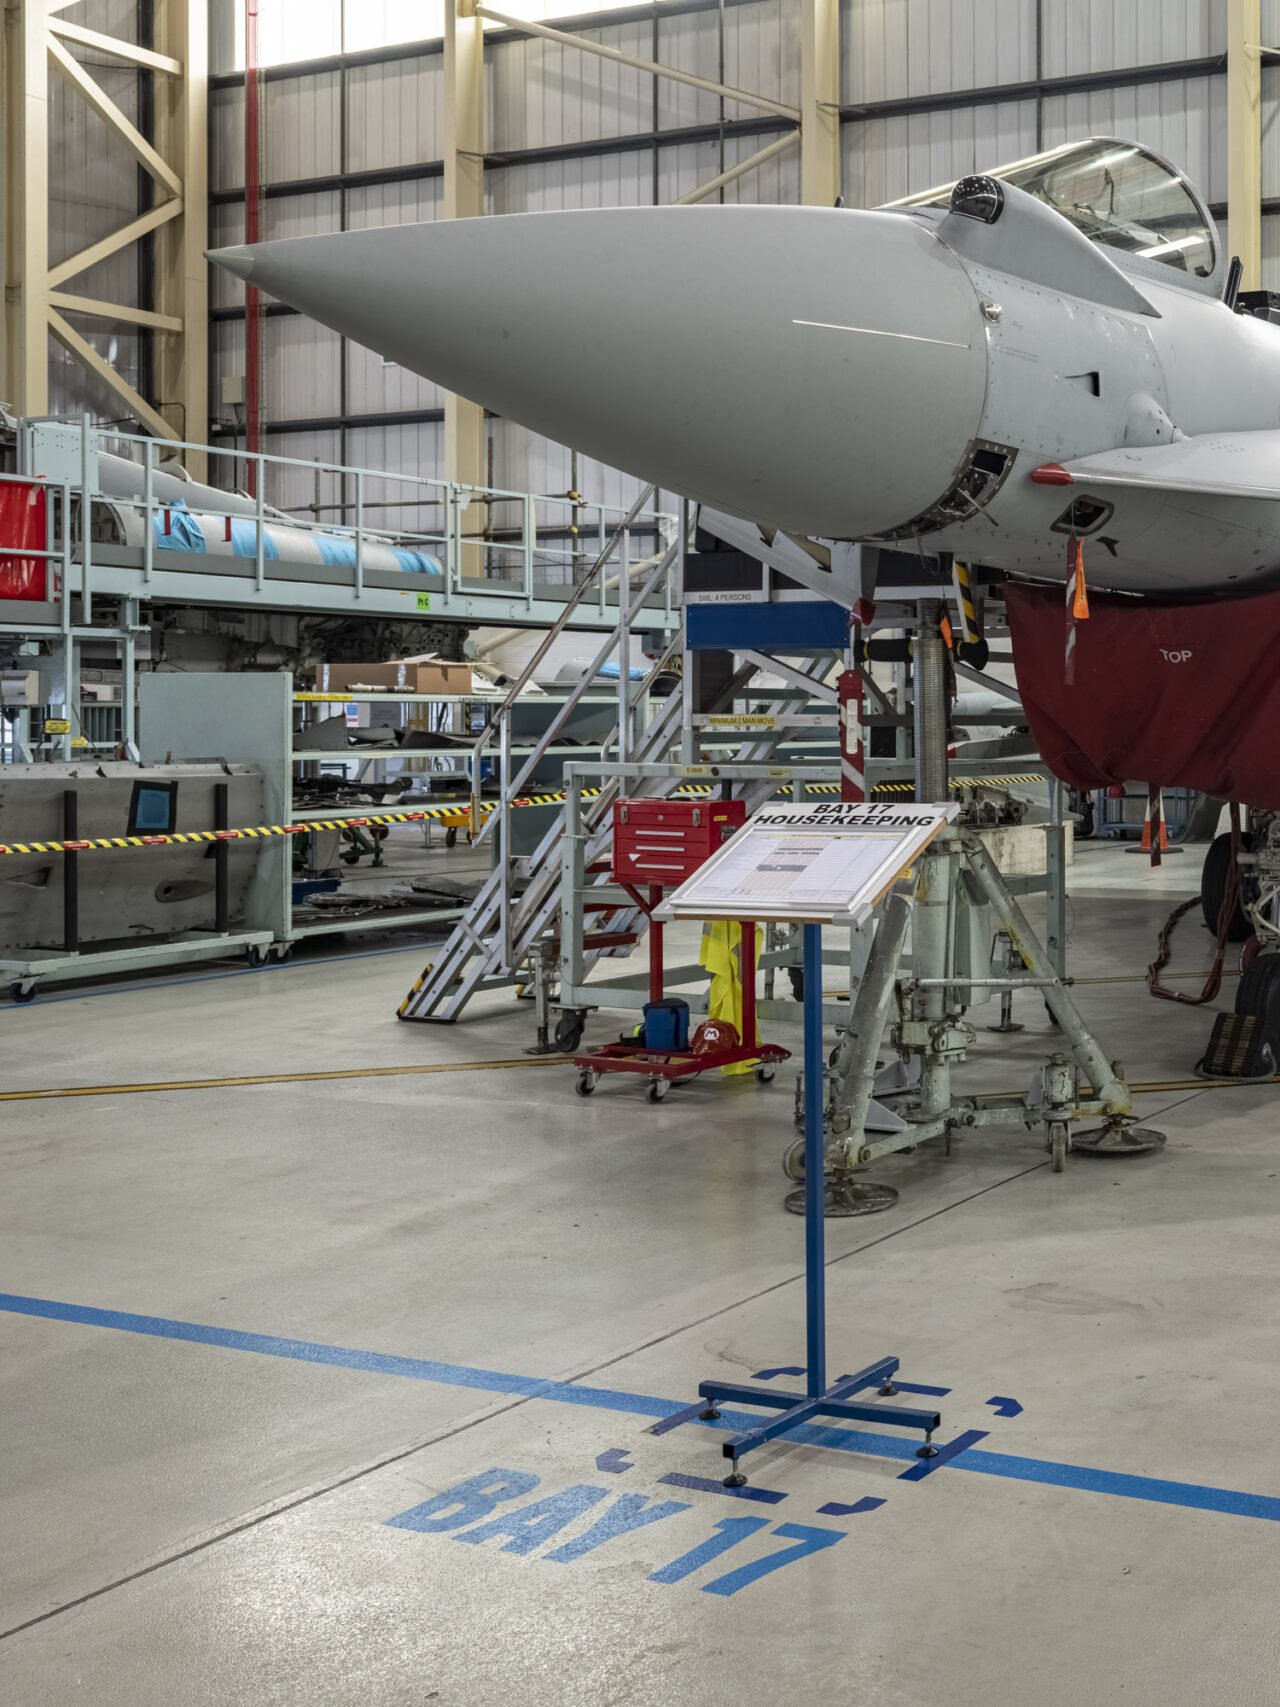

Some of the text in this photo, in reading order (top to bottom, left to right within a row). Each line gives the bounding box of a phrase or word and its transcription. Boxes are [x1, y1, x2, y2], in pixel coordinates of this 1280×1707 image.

[1160, 649, 1192, 663] TOP
[813, 804, 894, 814] BAY 17
[753, 815, 935, 826] HOUSEKEEPING
[381, 1466, 849, 1598] BAY 17
